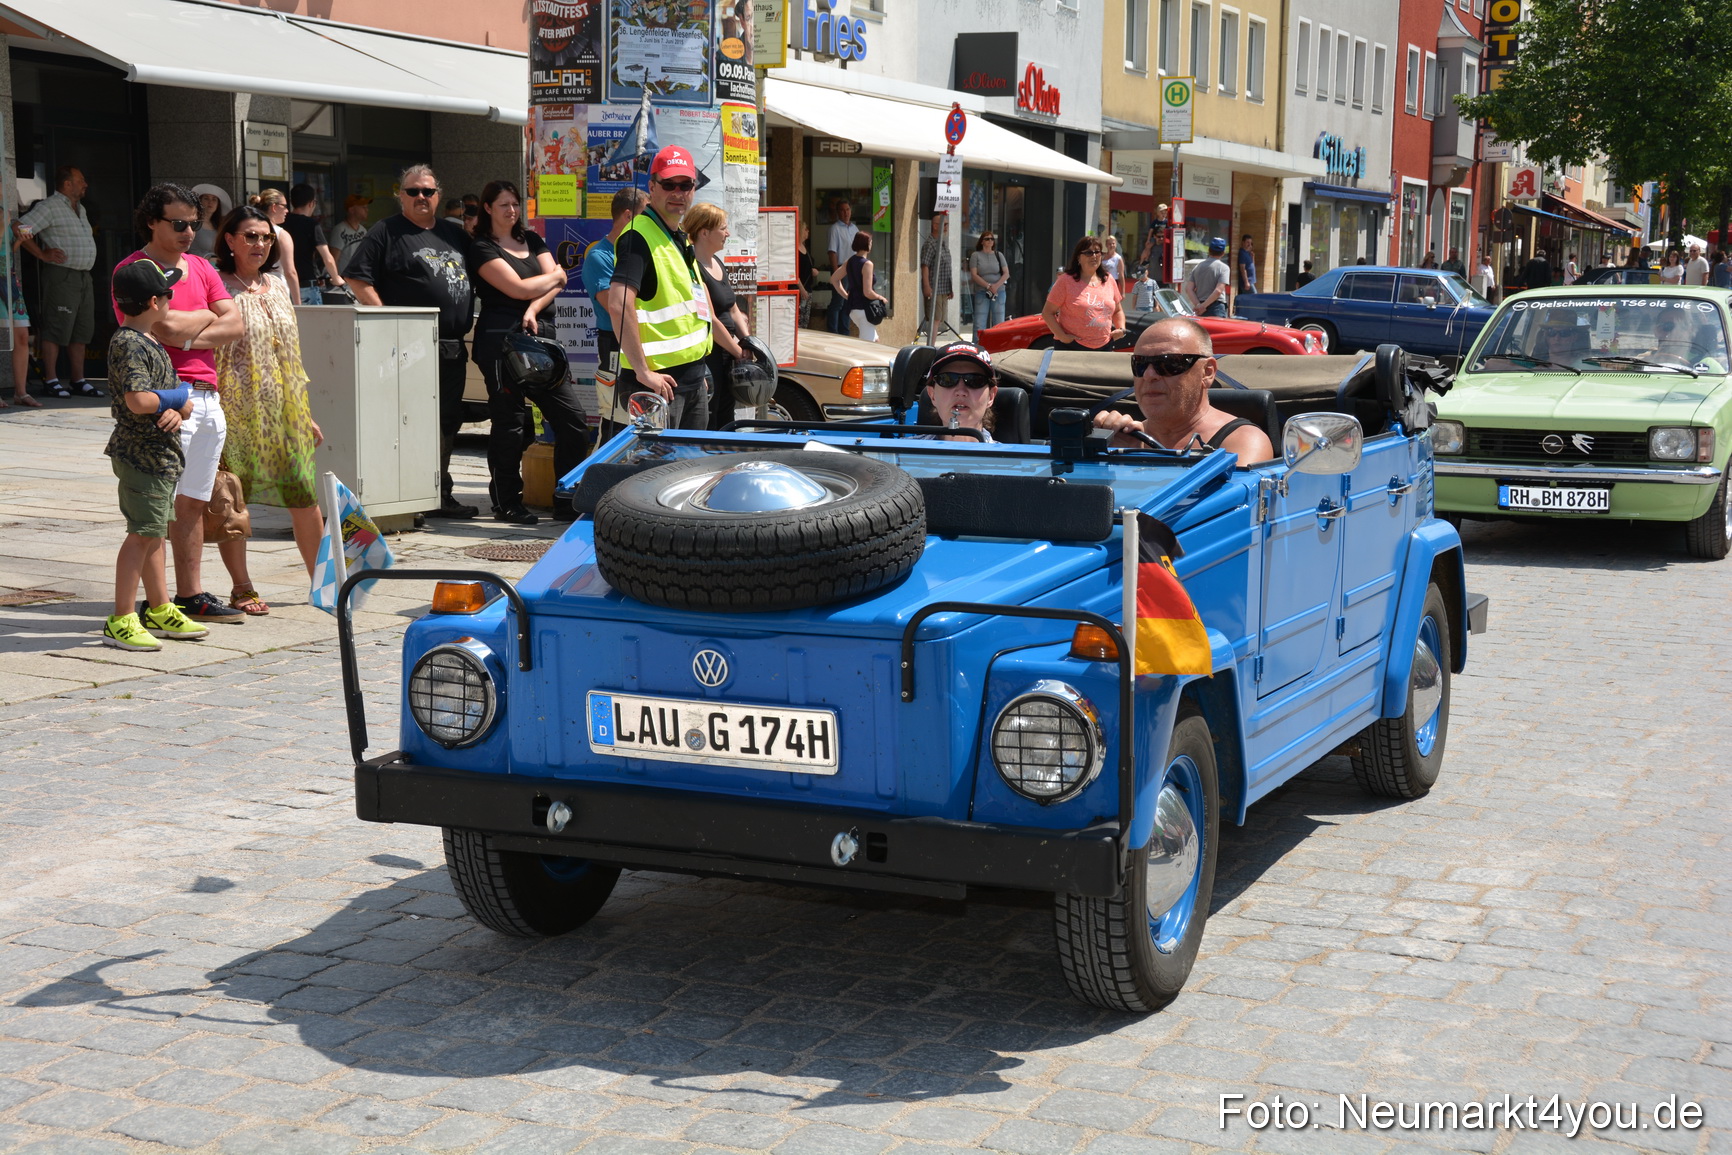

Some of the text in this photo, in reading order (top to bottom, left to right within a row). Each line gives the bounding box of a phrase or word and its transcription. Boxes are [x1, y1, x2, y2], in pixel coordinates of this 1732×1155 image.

[538, 24, 576, 39] AFTER PARTY
[619, 27, 703, 40] 36. Lengenfelder Wiesenfest
[962, 71, 1007, 89] s.Oliver
[1017, 62, 1061, 115] s.Oliver
[725, 152, 748, 164] Sonntag,
[556, 305, 594, 318] Mistle Toe
[1530, 299, 1692, 310] Opelschwenker TSG olé olé
[580, 340, 594, 348] Juni
[1509, 488, 1608, 508] RH BM 878H
[614, 702, 831, 760] LAU G 174H
